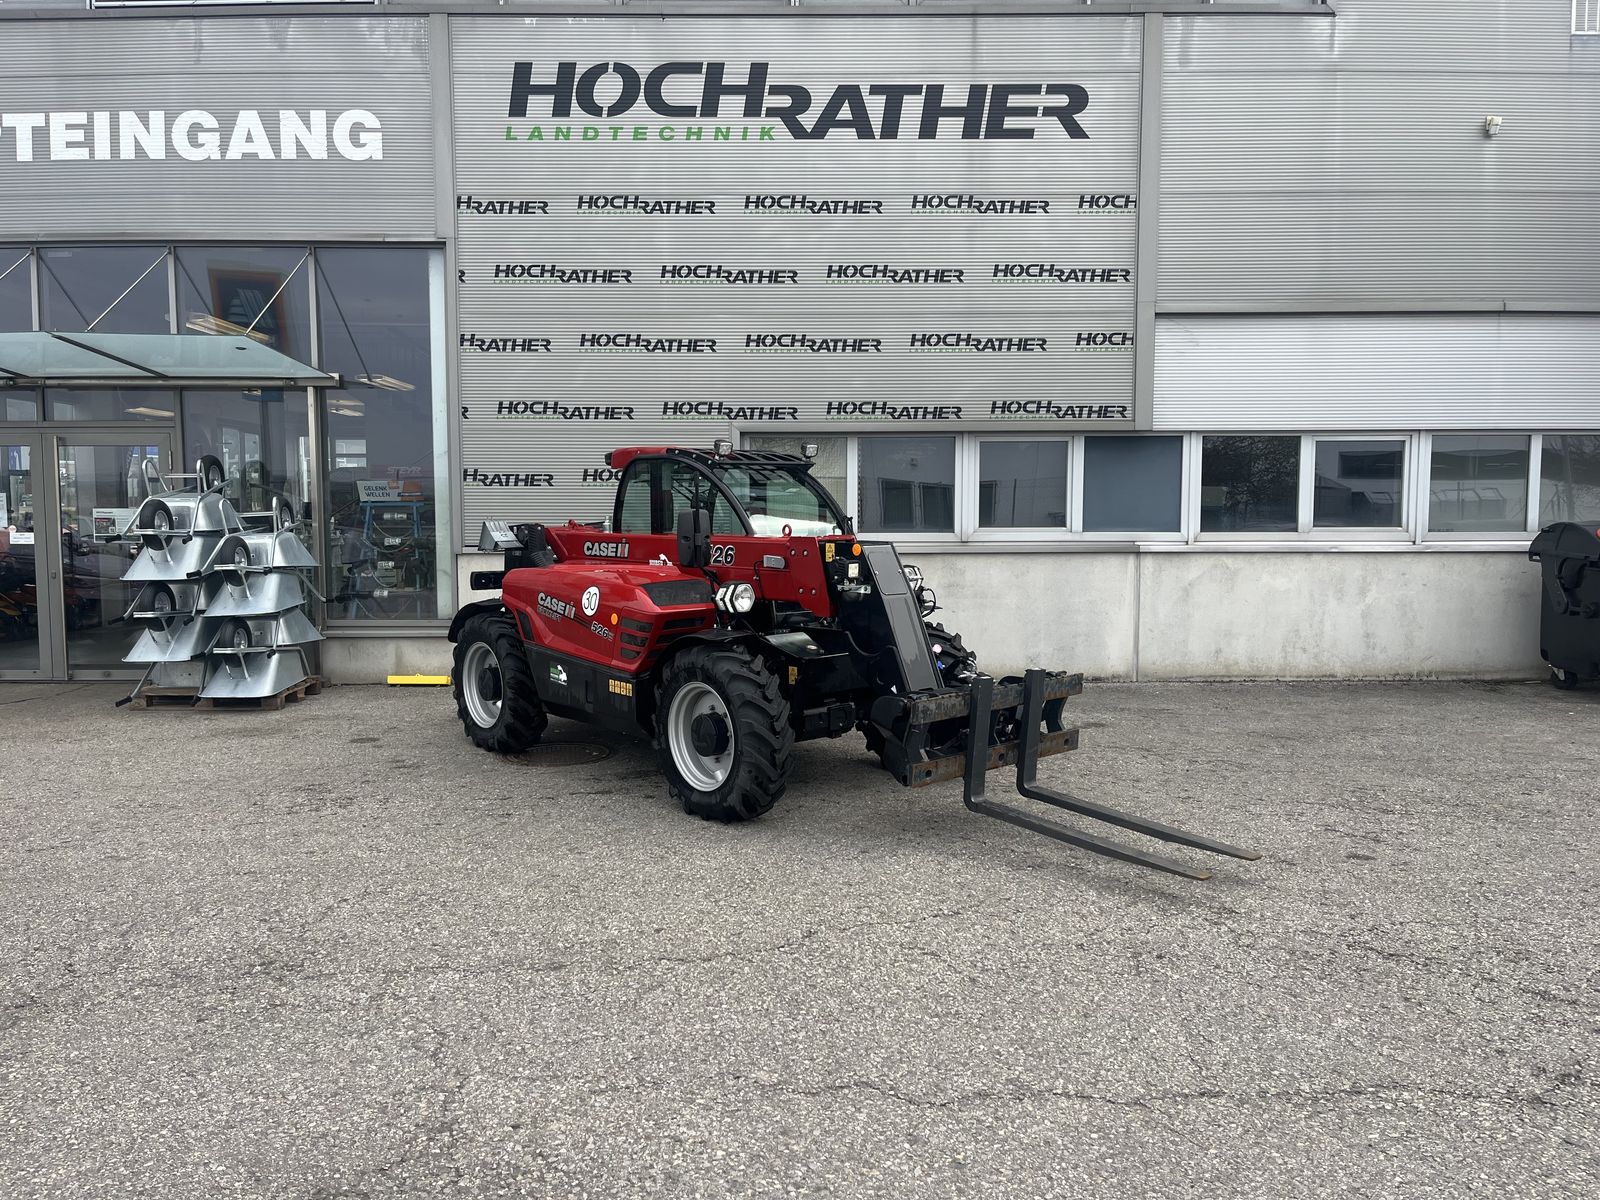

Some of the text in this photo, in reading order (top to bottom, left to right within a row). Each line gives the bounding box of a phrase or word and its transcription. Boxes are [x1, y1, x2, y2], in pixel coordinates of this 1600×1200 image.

[508, 61, 1091, 139] HOCHRATHER
[0, 109, 383, 161] TEINGANG
[505, 126, 775, 141] LANDTECHNIK
[577, 195, 716, 214] HOCHRATHER
[744, 195, 883, 214] HOCHRATHER
[911, 195, 1050, 214] HOCHRATHER
[494, 264, 632, 283] HOCHRATHER
[660, 265, 799, 284] HOCHRATHER
[826, 264, 965, 283] HOCHRATHER
[992, 263, 1131, 282] HOCHRATHER
[579, 333, 717, 352] HOCHRATHER
[745, 334, 882, 353] HOCHRATHER
[910, 333, 1048, 351] HOCHRATHER
[497, 400, 635, 420] HOCHRATHER
[662, 401, 799, 420] HOCHRATHER
[826, 401, 963, 419] HOCHRATHER
[990, 400, 1128, 418] HOCHRATHER
[583, 541, 616, 557] CASE
[710, 544, 736, 566] 26
[538, 592, 565, 615] CASE
[584, 591, 598, 611] 30
[591, 620, 609, 640] 526
